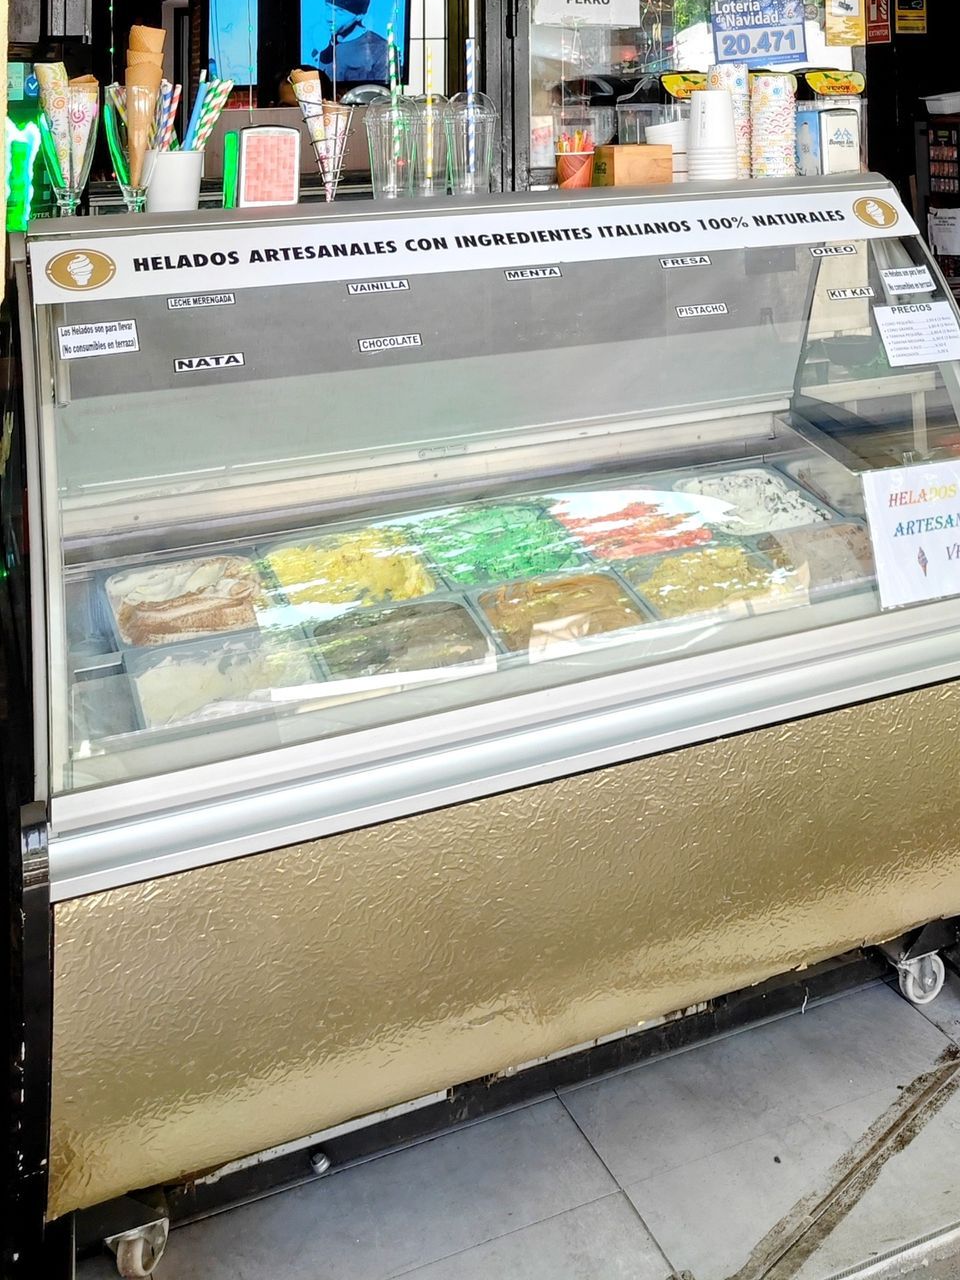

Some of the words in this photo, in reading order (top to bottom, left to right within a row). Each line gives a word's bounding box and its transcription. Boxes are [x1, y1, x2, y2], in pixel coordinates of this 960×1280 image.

[715, 0, 761, 15] Lotería
[725, 10, 780, 29] Navidad
[722, 29, 797, 57] 20.471
[133, 251, 240, 272] HELADOS
[249, 240, 398, 264] ARTESANALES
[405, 236, 449, 252] CON
[455, 226, 593, 249] INGREDIENTES
[597, 219, 692, 238] ITALIANOS
[697, 216, 749, 232] 100%
[751, 209, 846, 227] NATURALES
[812, 246, 854, 255] OREO
[662, 256, 709, 267] FRESA
[507, 268, 559, 280] MENTA
[350, 281, 407, 293] VAINILLA
[829, 290, 847, 298] KIT
[851, 288, 872, 297] KAT
[170, 297, 192, 308] LECHE
[192, 294, 233, 306] MERENGADA
[678, 305, 726, 317] PISTACHO
[890, 304, 933, 315] PRECIOS
[71, 326, 94, 336] Helados
[94, 325, 105, 333] son
[105, 324, 118, 334] para
[107, 341, 115, 350] en
[361, 335, 420, 350] CHOCOLATE
[176, 355, 242, 370] NATA
[888, 484, 959, 508] HELADOS
